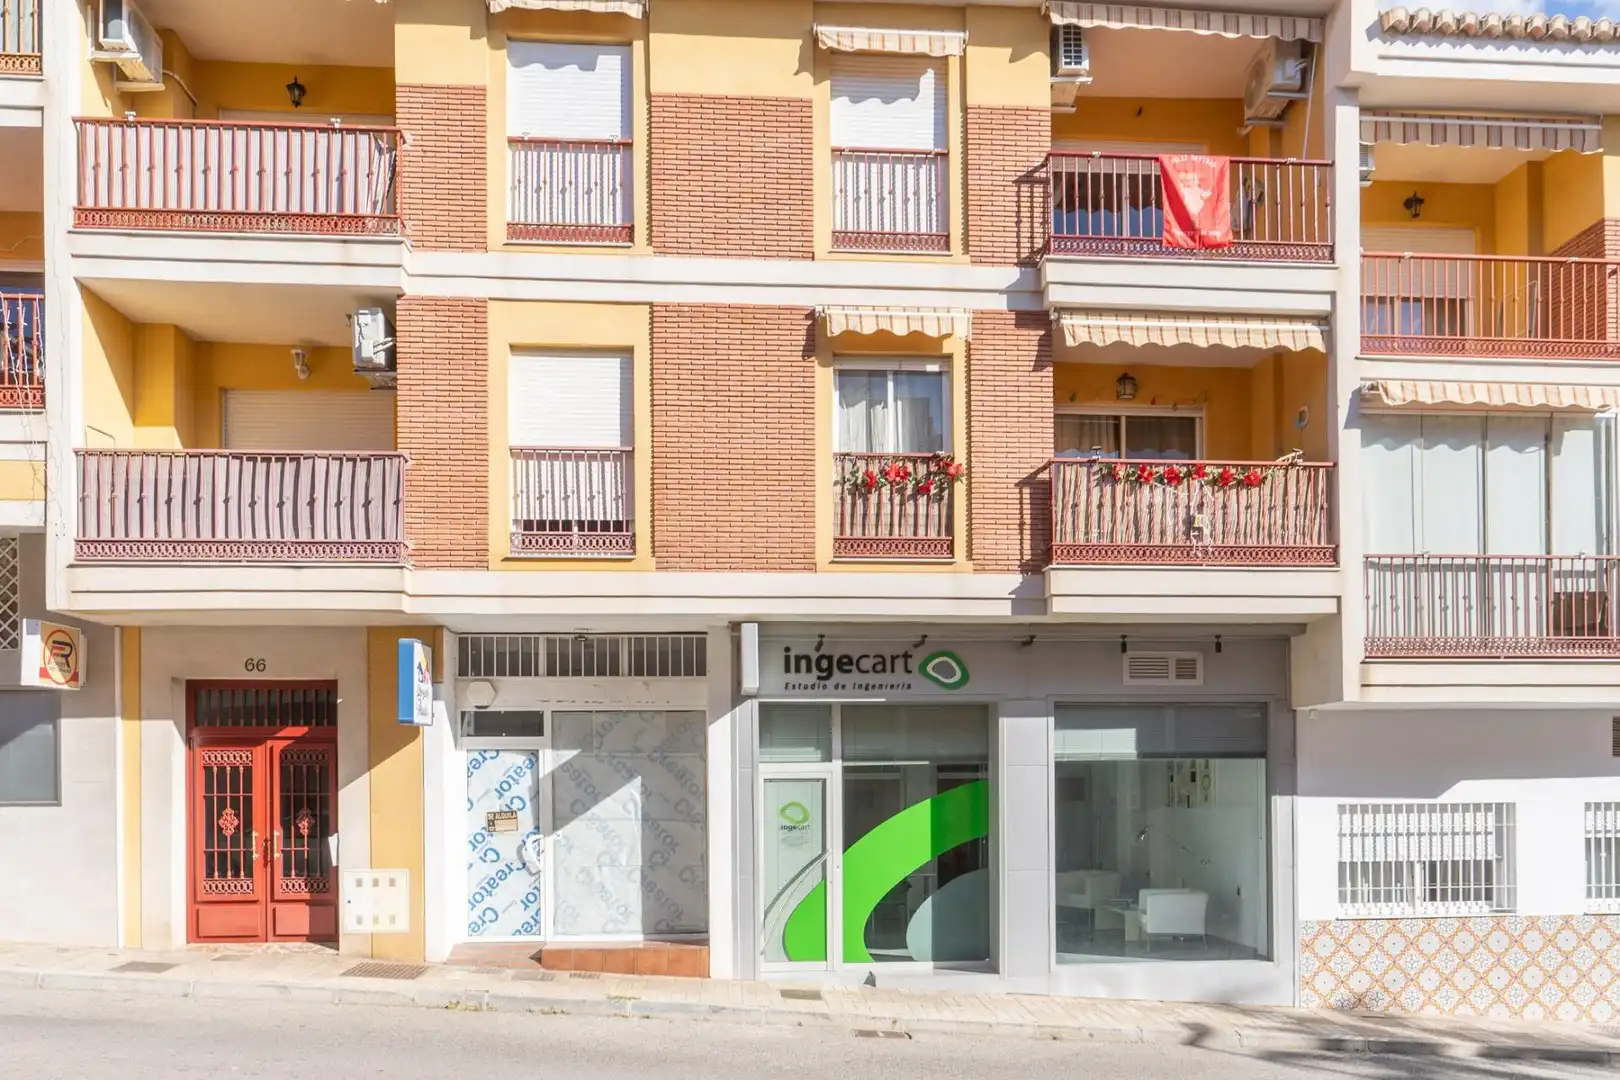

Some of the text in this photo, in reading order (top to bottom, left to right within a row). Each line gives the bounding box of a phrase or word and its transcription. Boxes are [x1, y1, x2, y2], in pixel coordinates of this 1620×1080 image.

[245, 658, 266, 672] 66
[784, 646, 913, 681] ingecart
[784, 682, 828, 691] Estudio
[834, 682, 847, 691] de
